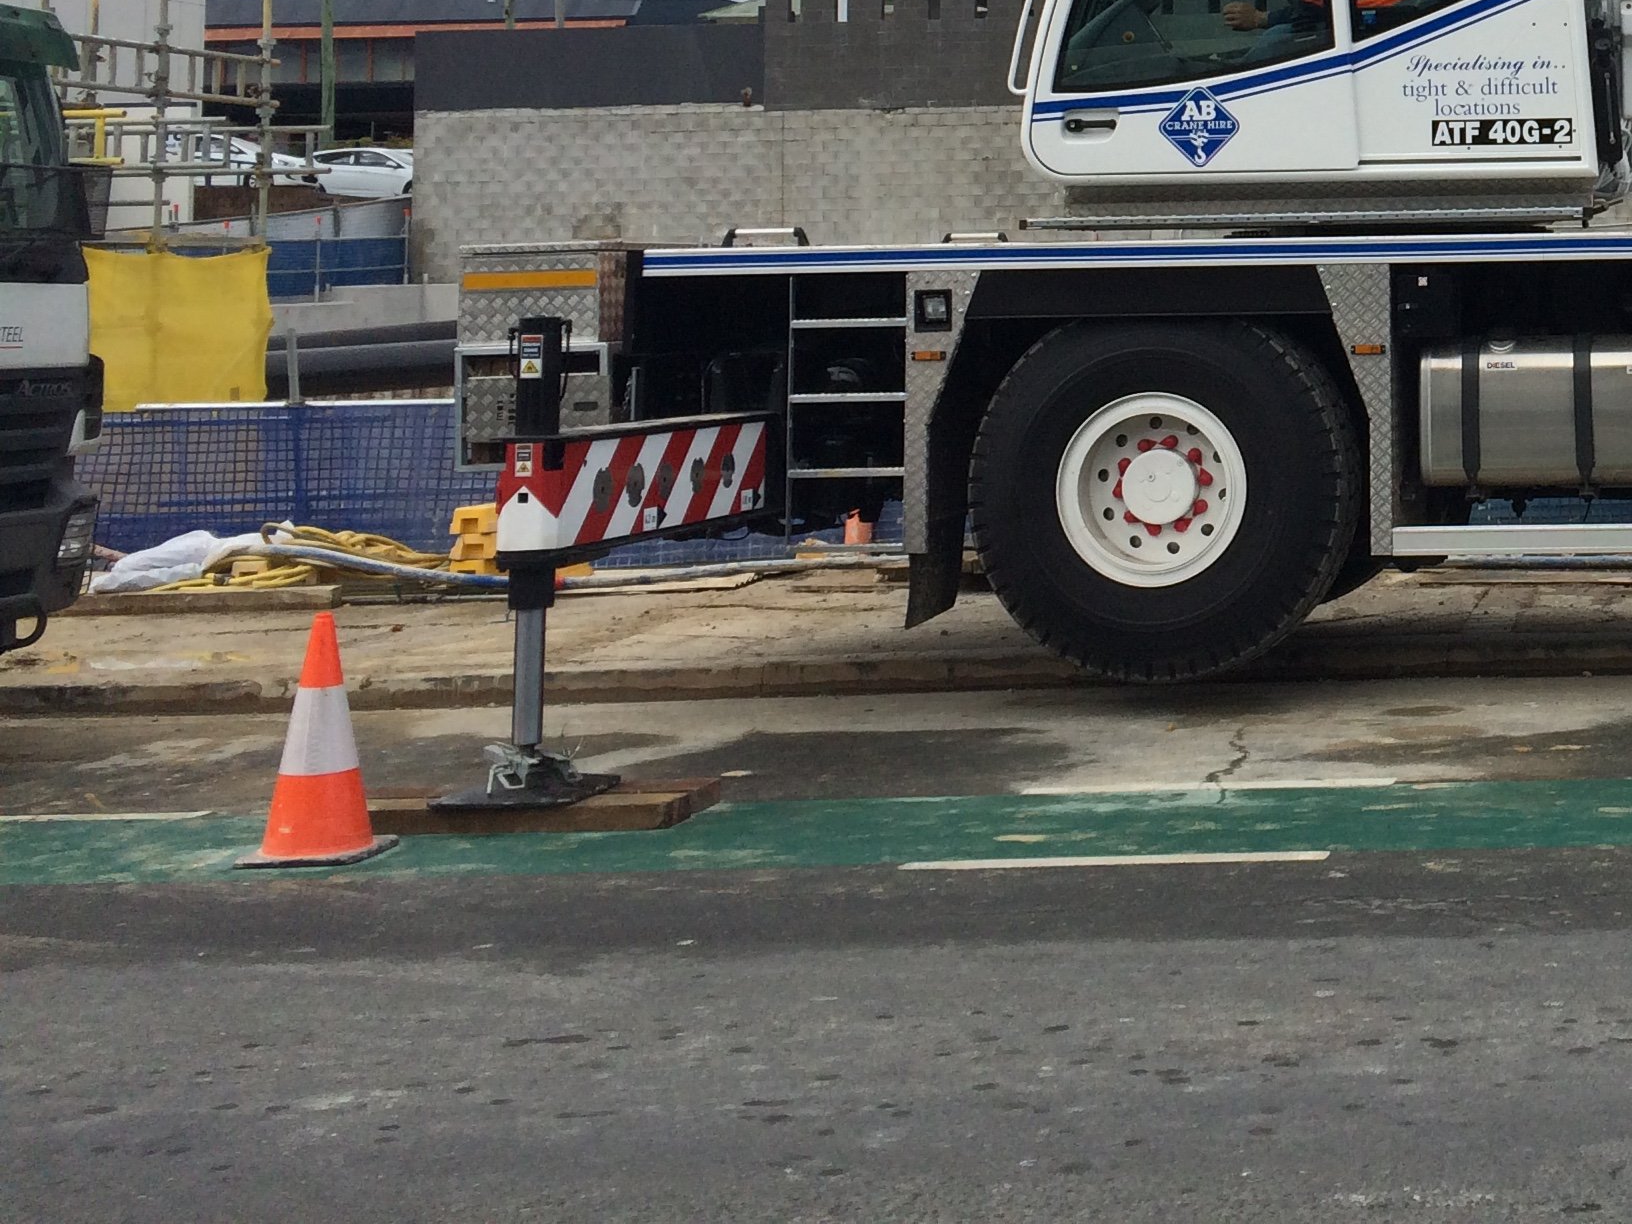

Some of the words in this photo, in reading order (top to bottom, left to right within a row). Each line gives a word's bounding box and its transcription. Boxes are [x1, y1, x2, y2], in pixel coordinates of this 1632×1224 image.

[1406, 54, 1525, 77] Specialising
[1402, 79, 1447, 102] tight
[1455, 80, 1473, 96] &
[1481, 77, 1558, 96] difficult
[1181, 100, 1217, 121] AB
[1435, 98, 1520, 116] locations
[1165, 121, 1204, 130] CRANE
[1207, 120, 1233, 129] HIRE
[1434, 121, 1480, 144] ATF
[1488, 120, 1571, 144] 40G-2
[0, 326, 24, 343] TEEL
[1487, 361, 1516, 369] DIESEL
